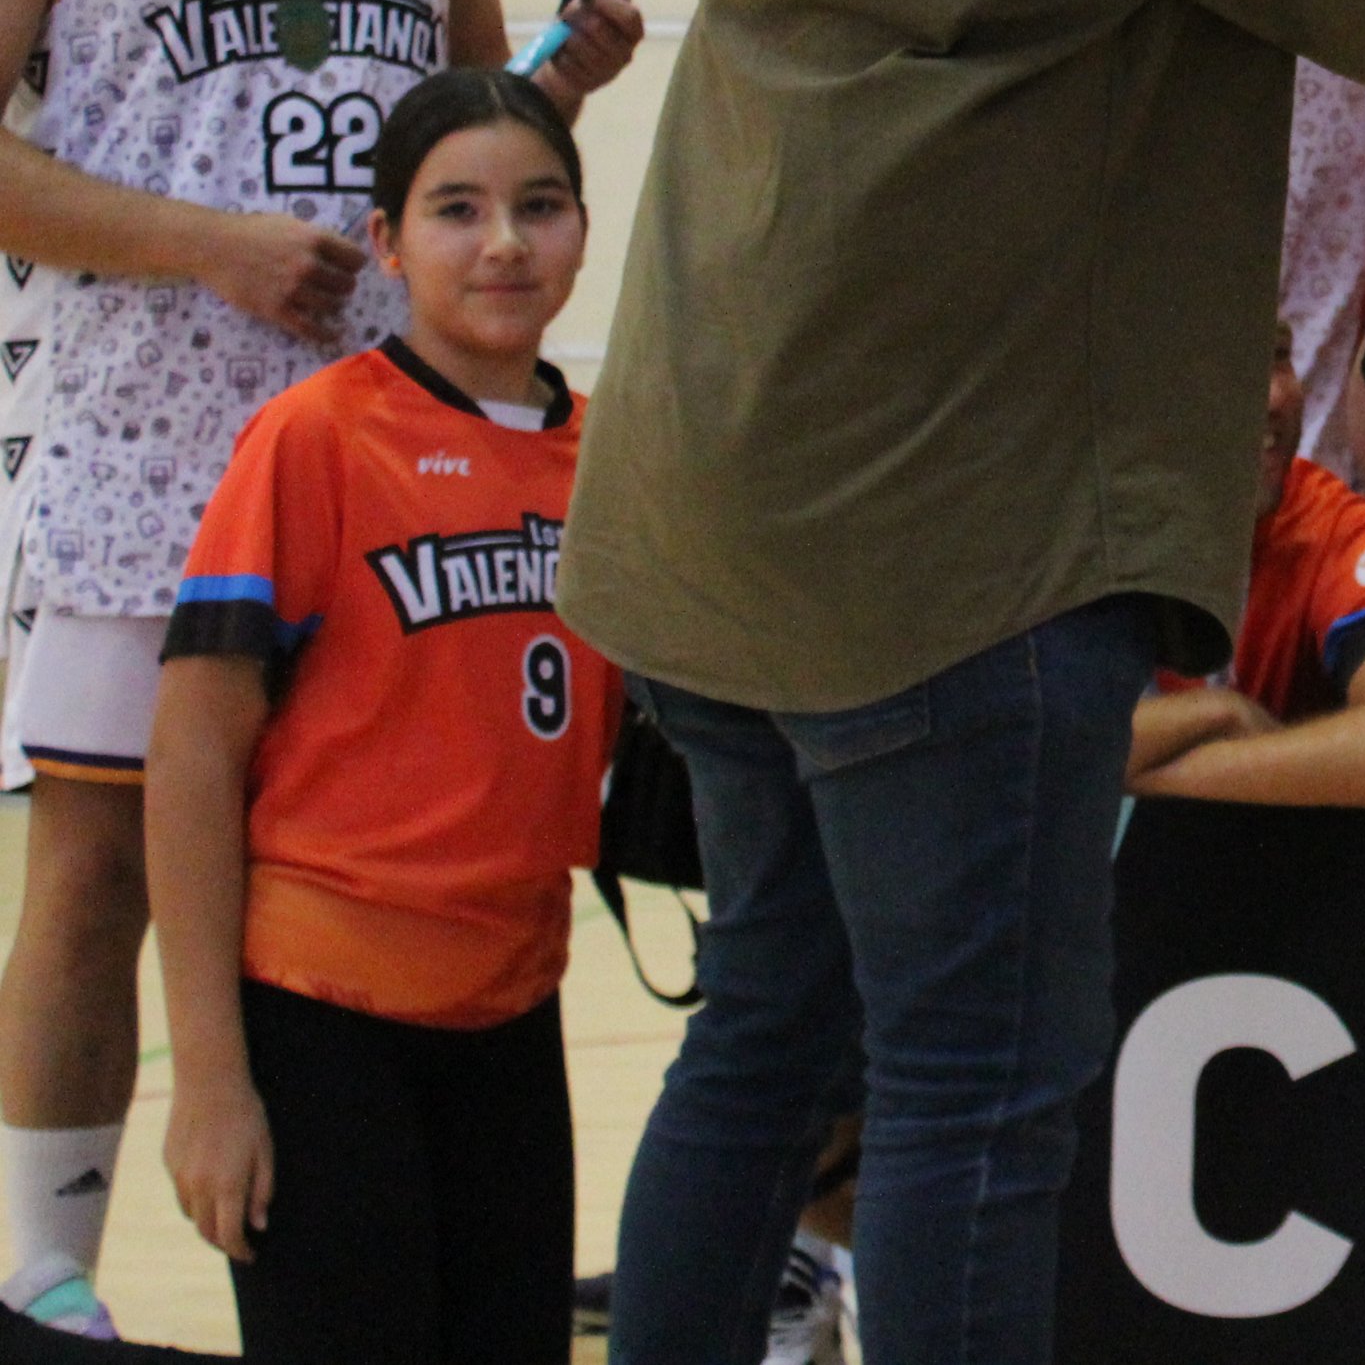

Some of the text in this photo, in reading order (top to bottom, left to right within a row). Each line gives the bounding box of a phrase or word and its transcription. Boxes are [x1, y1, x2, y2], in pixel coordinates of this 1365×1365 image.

[263, 90, 383, 195] 22
[374, 538, 561, 628] VALENC
[521, 634, 572, 740] 9
